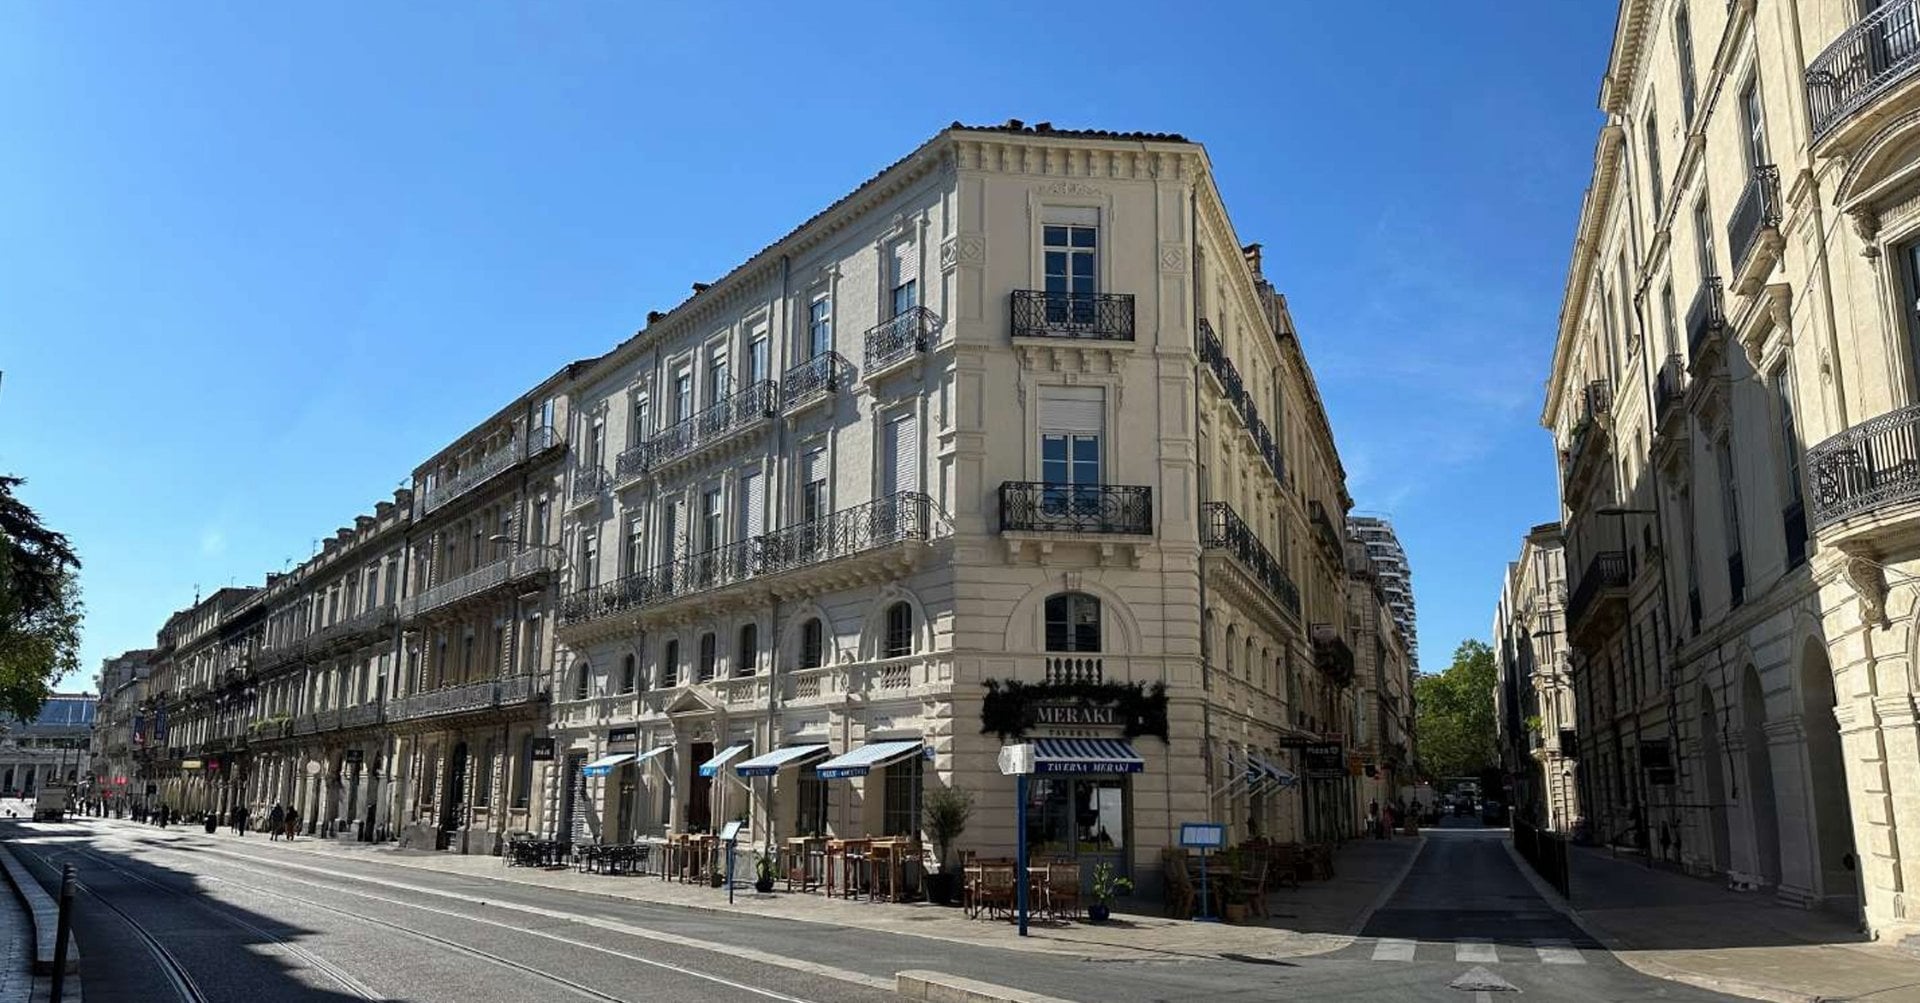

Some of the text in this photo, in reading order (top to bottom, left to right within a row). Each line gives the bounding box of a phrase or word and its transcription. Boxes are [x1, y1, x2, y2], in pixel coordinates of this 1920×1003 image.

[1037, 708, 1113, 723] MERAKI
[1049, 729, 1100, 737] TAVERNA
[1047, 763, 1129, 772] TAVERNA MERAKI
